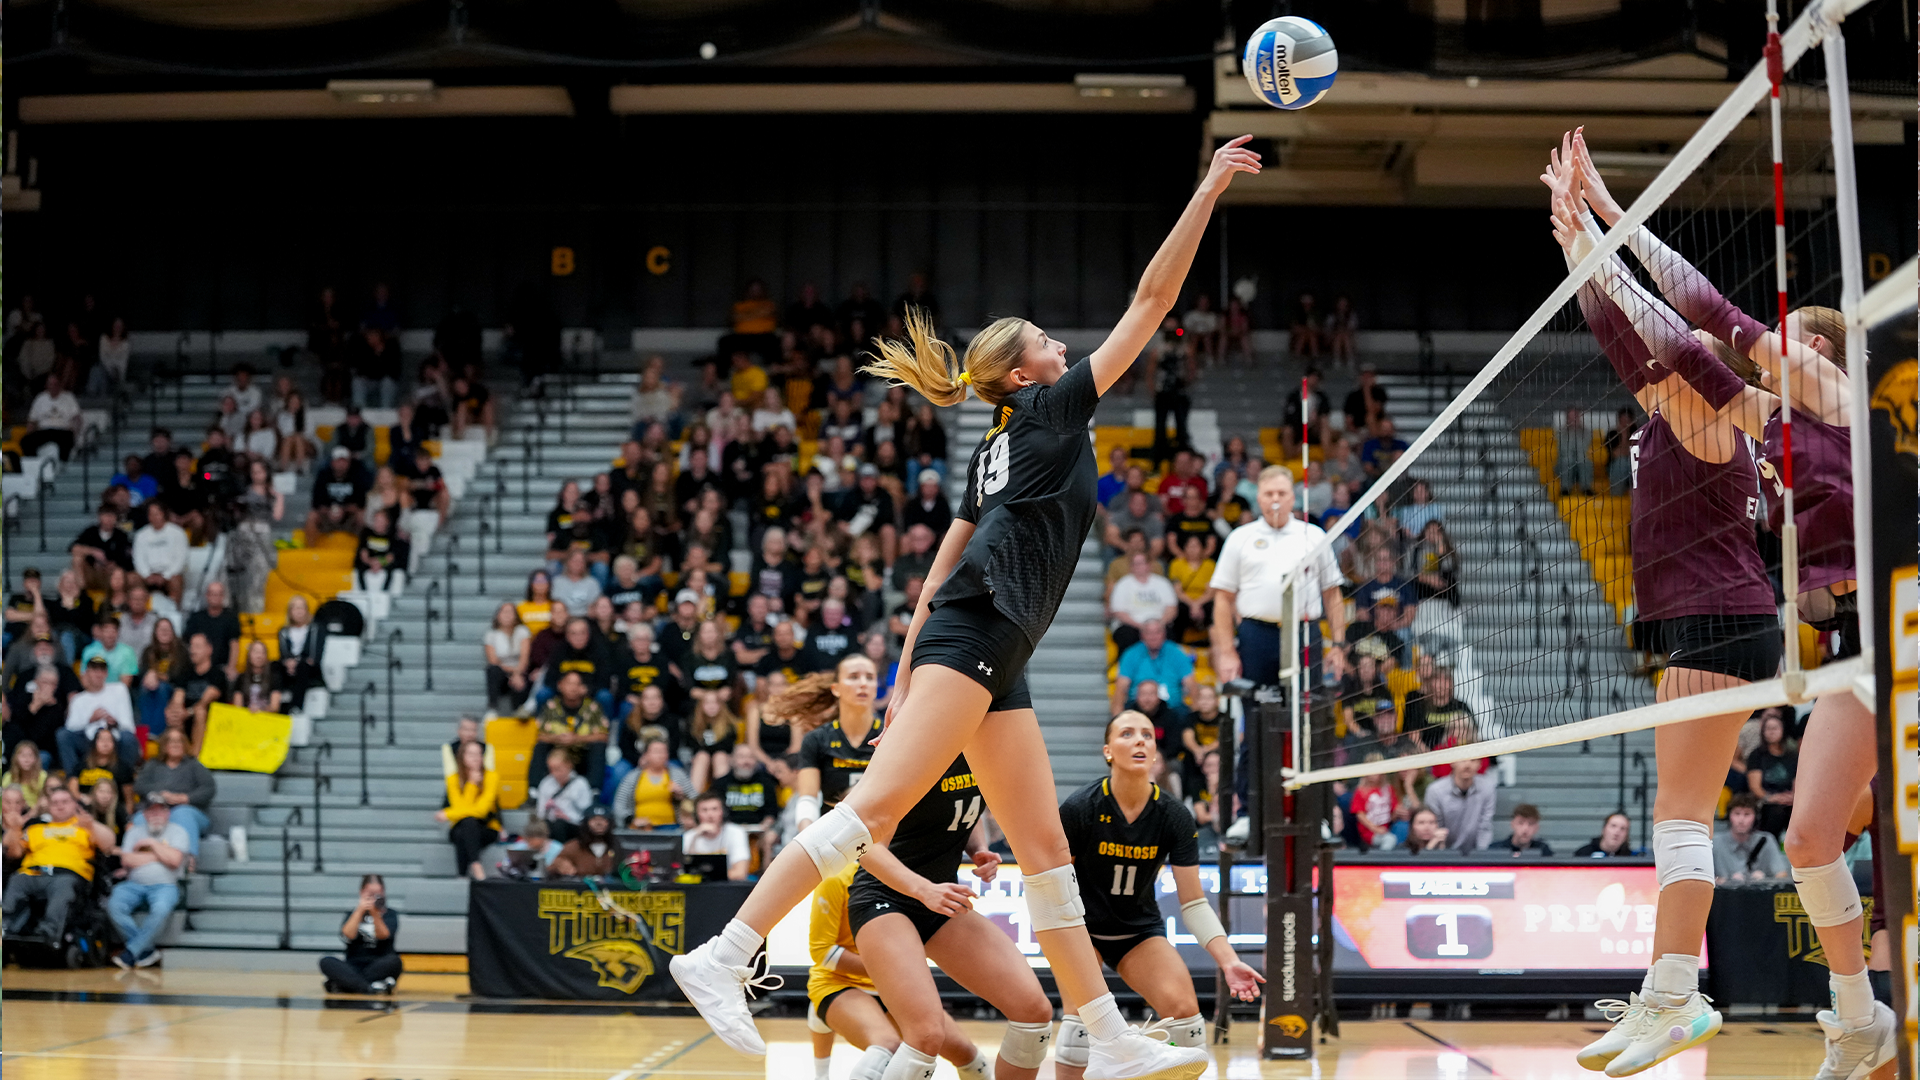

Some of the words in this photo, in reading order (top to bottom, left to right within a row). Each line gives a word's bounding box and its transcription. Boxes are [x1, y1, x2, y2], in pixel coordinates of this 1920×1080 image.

[1258, 50, 1275, 92] NCAA
[1276, 44, 1291, 95] molten
[551, 247, 574, 275] B
[646, 246, 670, 274] C
[1869, 253, 1890, 280] D
[977, 432, 1010, 507] 19
[941, 773, 977, 792] OSHKO
[947, 795, 981, 831] 14
[1099, 841, 1158, 859] OSHKOSH
[1111, 865, 1137, 895] 11
[1282, 911, 1297, 953] sports
[1436, 913, 1469, 955] 1
[1281, 953, 1296, 1001] imports
